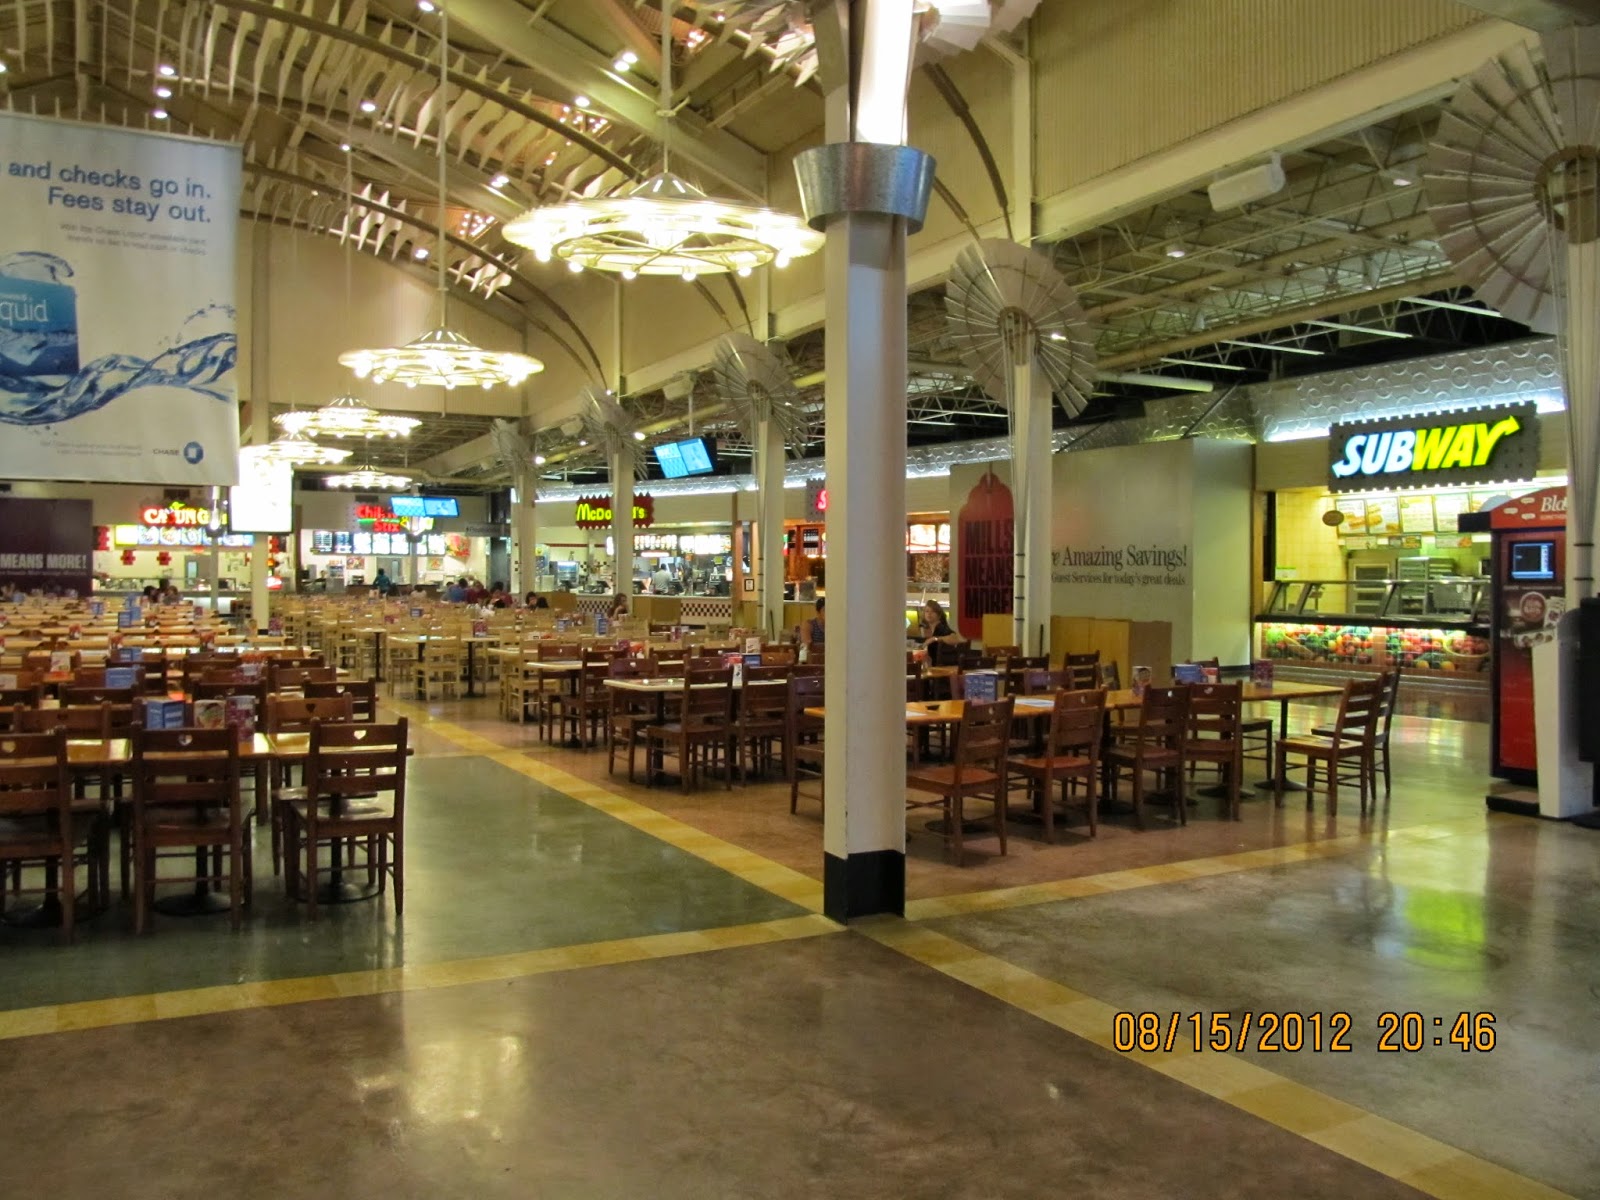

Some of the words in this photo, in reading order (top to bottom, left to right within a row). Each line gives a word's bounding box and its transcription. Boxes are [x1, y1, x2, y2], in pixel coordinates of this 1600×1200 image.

[8, 161, 52, 180] and
[59, 165, 142, 191] checks
[149, 178, 178, 198] go
[185, 177, 211, 199] in.
[48, 186, 104, 211] Fees
[112, 197, 160, 222] stay
[168, 204, 211, 223] out.
[1332, 415, 1520, 478] SUBWAY
[0, 553, 44, 569] MEANS
[46, 553, 87, 569] MORE!
[965, 557, 1014, 586] MEANS
[1062, 545, 1124, 571] Amazing
[1126, 544, 1187, 572] Savings!
[1072, 571, 1102, 583] Services
[1102, 571, 1113, 583] for
[1114, 571, 1141, 585] today's
[1142, 574, 1162, 586] great
[1164, 572, 1185, 585] deals
